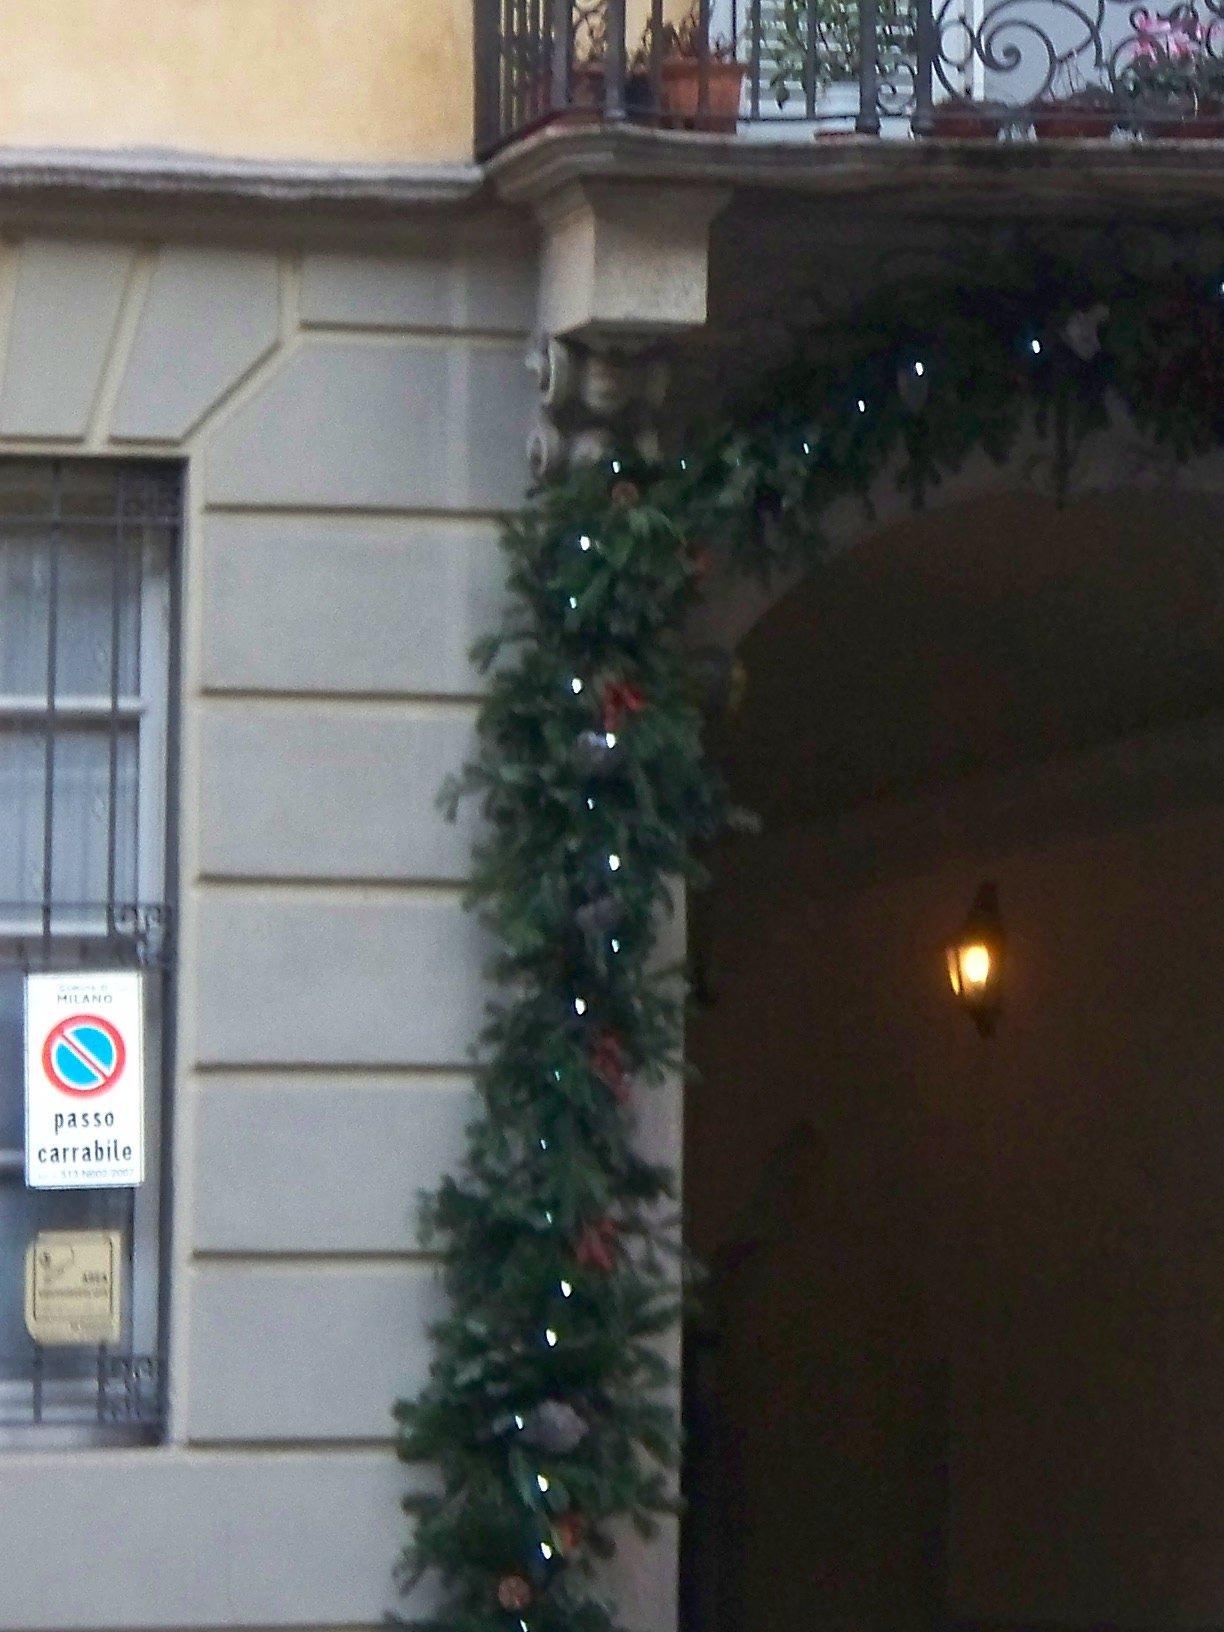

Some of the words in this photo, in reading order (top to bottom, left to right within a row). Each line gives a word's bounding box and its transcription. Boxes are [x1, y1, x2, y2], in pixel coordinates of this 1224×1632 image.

[56, 994, 113, 1004] MILANO
[54, 1112, 114, 1136] passo
[38, 1139, 132, 1163] carrabile
